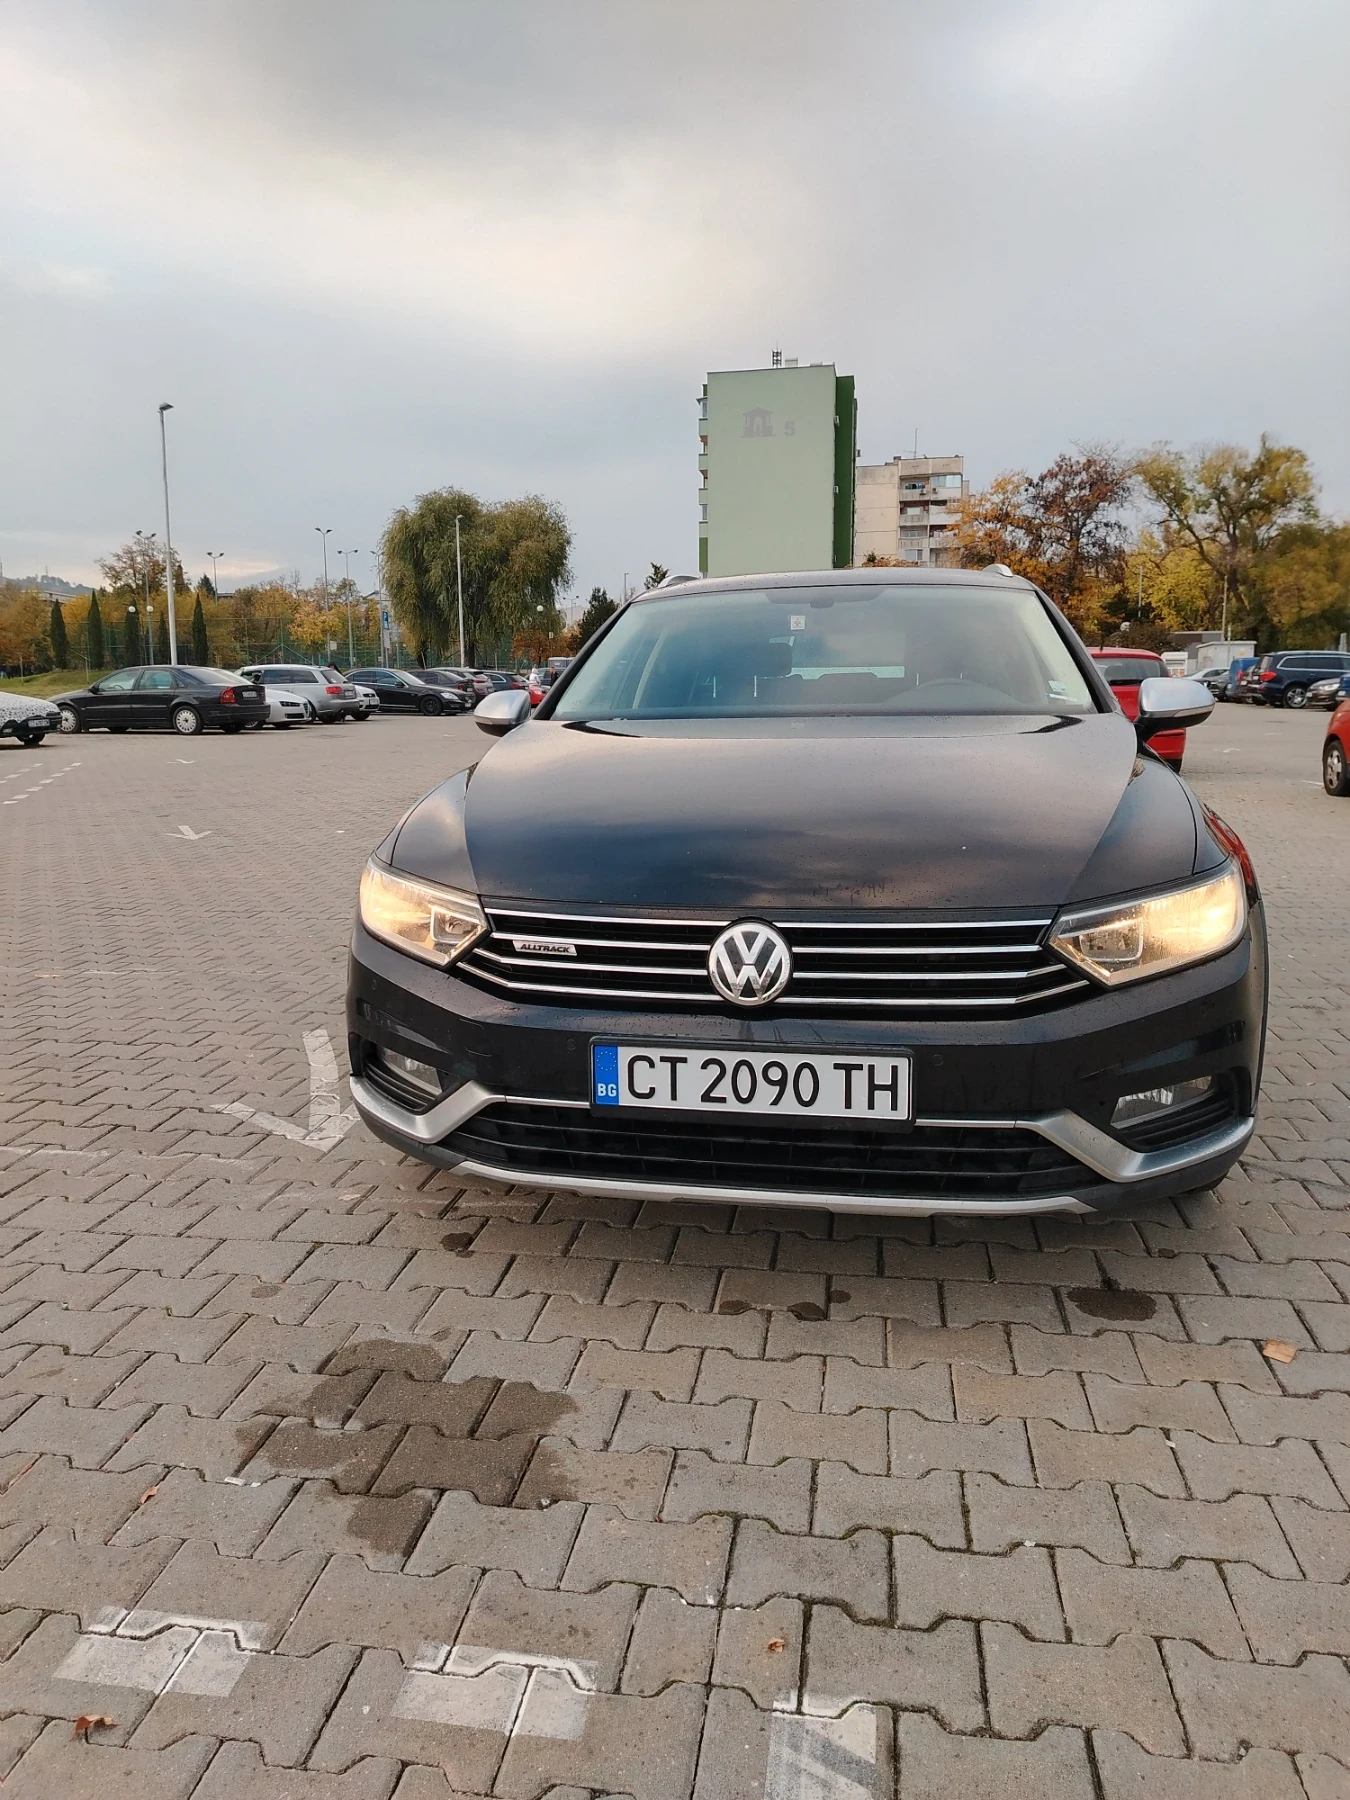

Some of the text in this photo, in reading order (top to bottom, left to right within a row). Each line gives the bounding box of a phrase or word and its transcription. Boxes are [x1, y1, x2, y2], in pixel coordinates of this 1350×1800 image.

[784, 421, 796, 436] 5
[520, 943, 570, 953] ALLTRACK
[709, 922, 790, 1006] VW
[597, 1083, 617, 1097] BG
[627, 1054, 899, 1112] CT 2090 TH
